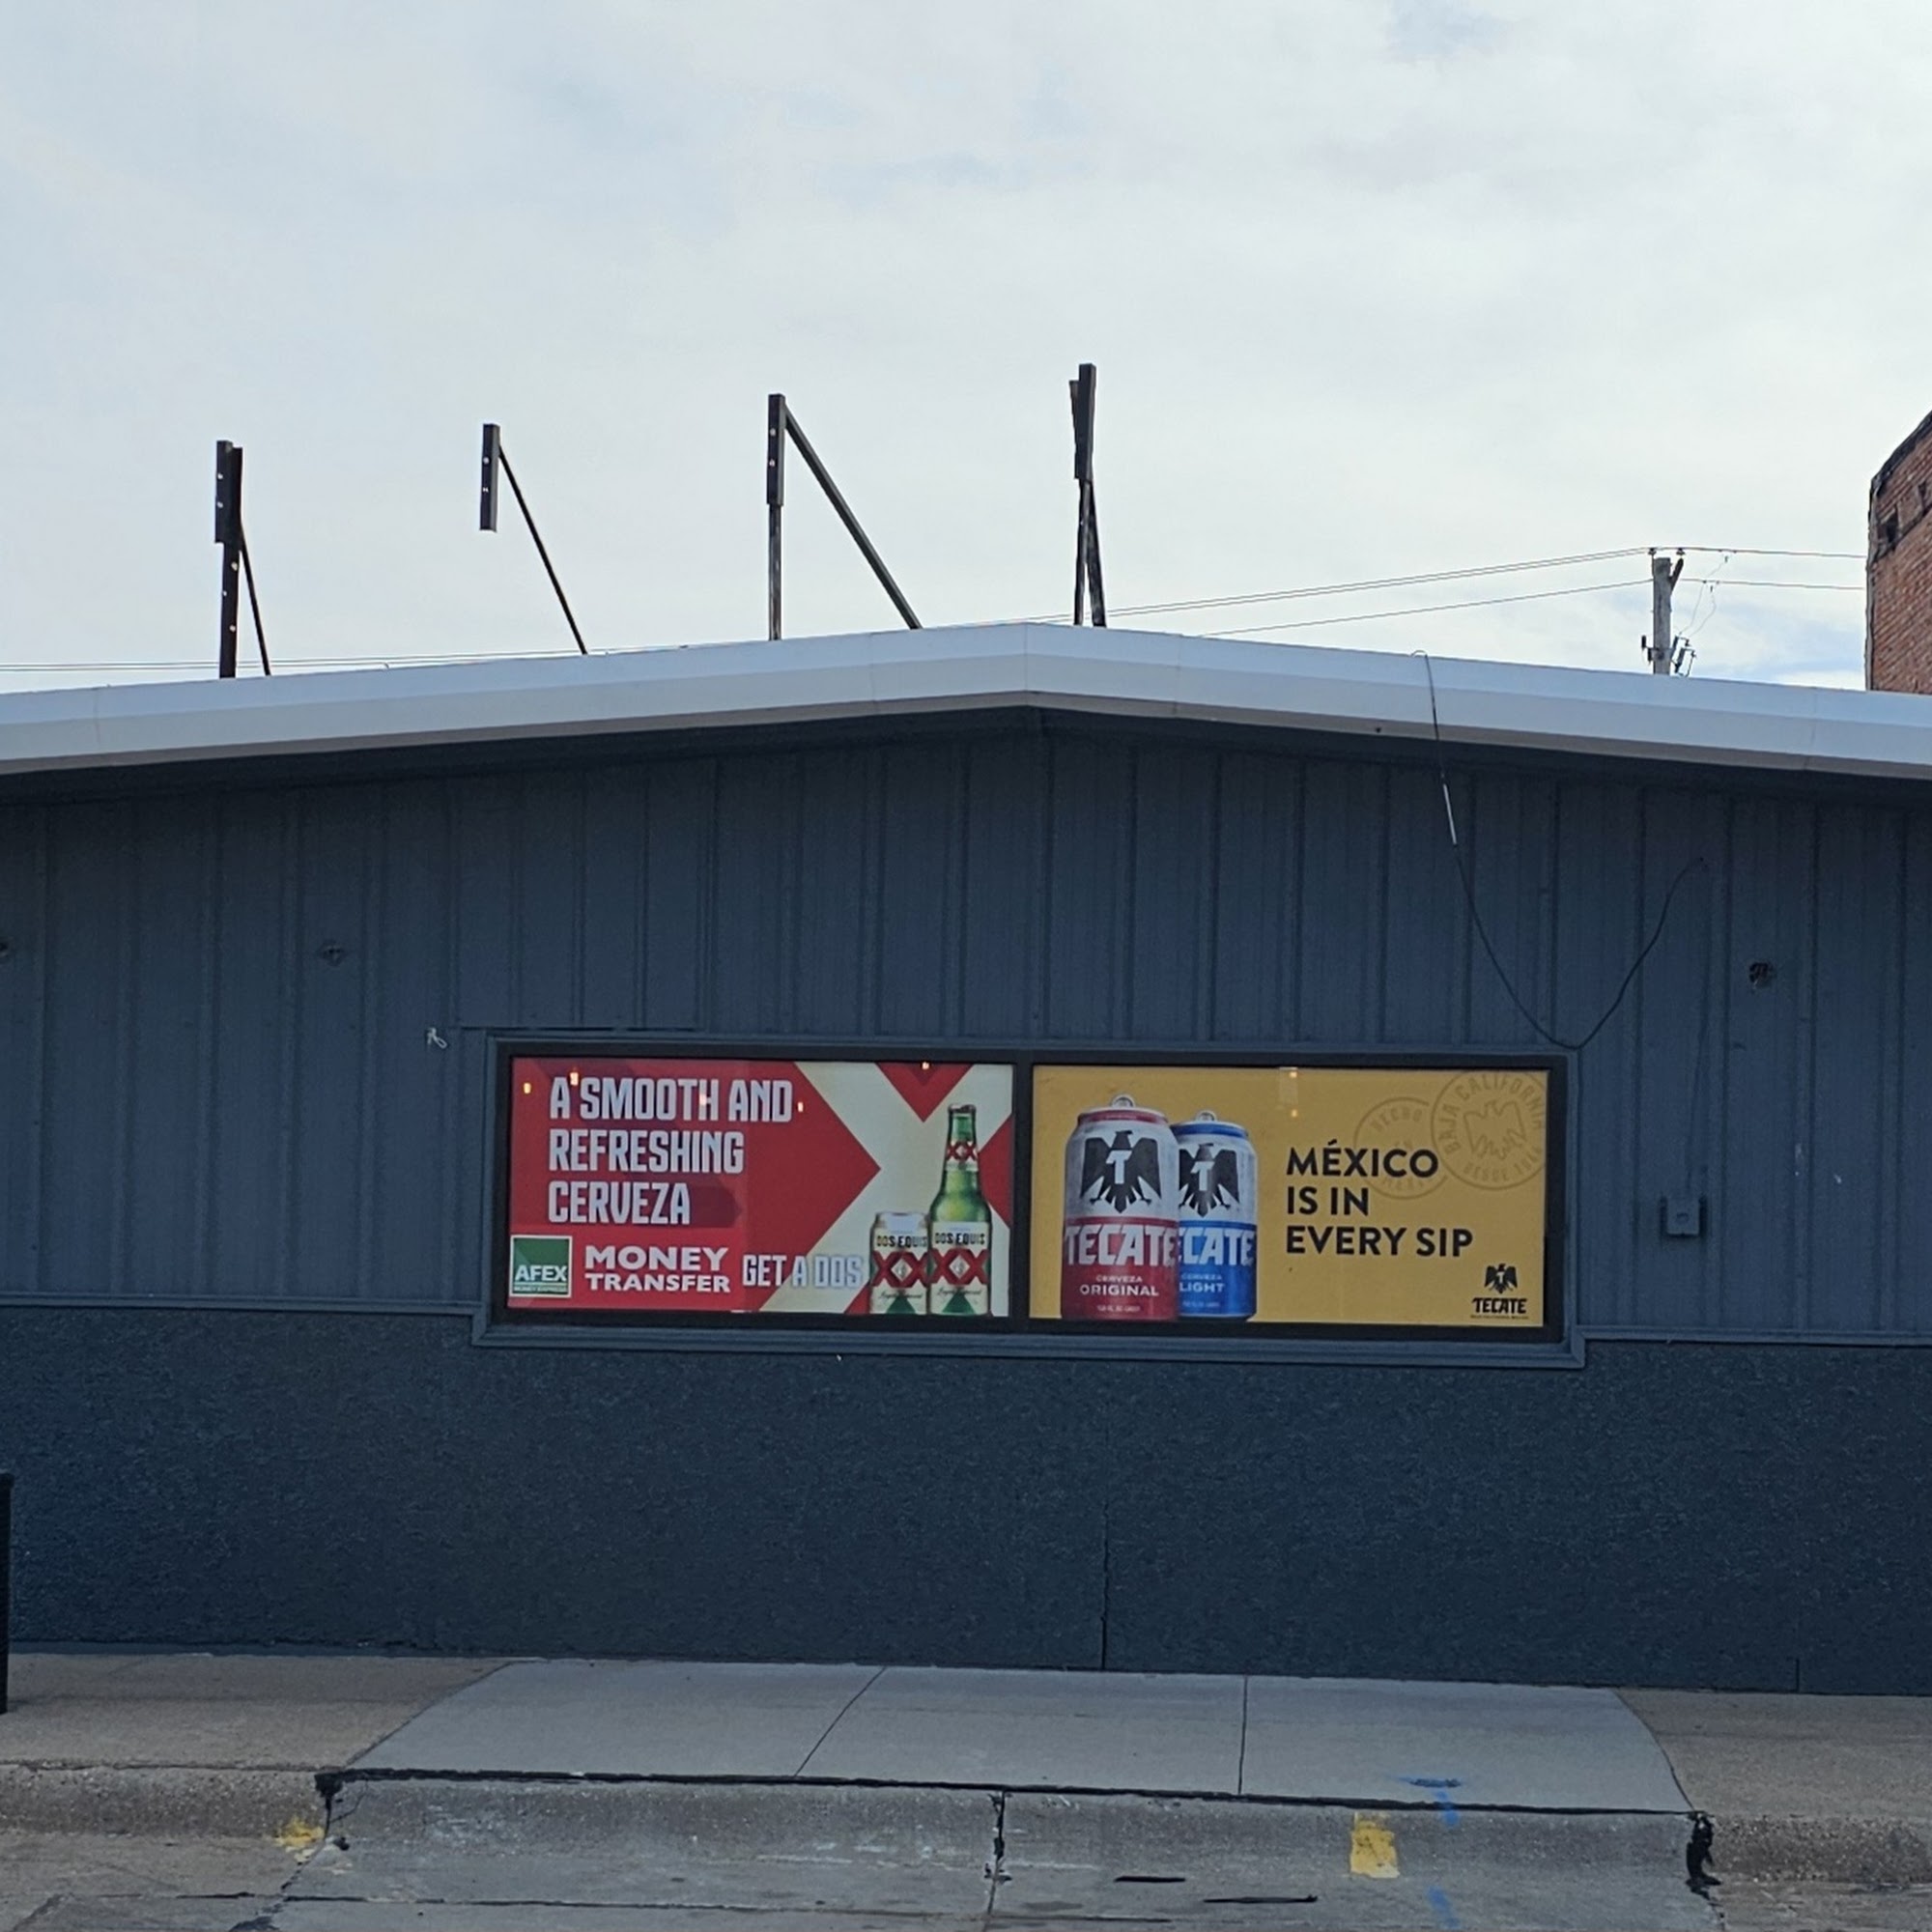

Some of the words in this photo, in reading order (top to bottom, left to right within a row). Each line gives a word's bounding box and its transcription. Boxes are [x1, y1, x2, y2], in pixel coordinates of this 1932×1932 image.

[550, 1076, 571, 1120] A
[580, 1077, 720, 1122] SMOOTH
[727, 1079, 793, 1122] AND
[549, 1128, 745, 1174] REFRESHING
[1286, 1139, 1438, 1178] MÉXICO
[548, 1180, 691, 1225] CERVEZA
[1287, 1186, 1318, 1215] IS
[1330, 1187, 1369, 1216] IN
[1065, 1224, 1178, 1266] TECATE
[1286, 1225, 1406, 1256] EVERY
[1416, 1227, 1473, 1257] SIP
[514, 1264, 567, 1282] AFEX
[584, 1245, 729, 1271] MONEY
[742, 1255, 787, 1287] GET
[791, 1255, 809, 1288] A
[814, 1255, 864, 1289] DOS
[584, 1272, 731, 1293] TRANSFER
[1080, 1283, 1159, 1296] ORIGINAL
[1179, 1282, 1226, 1293] LIGHT
[1471, 1297, 1528, 1314] TECATE
